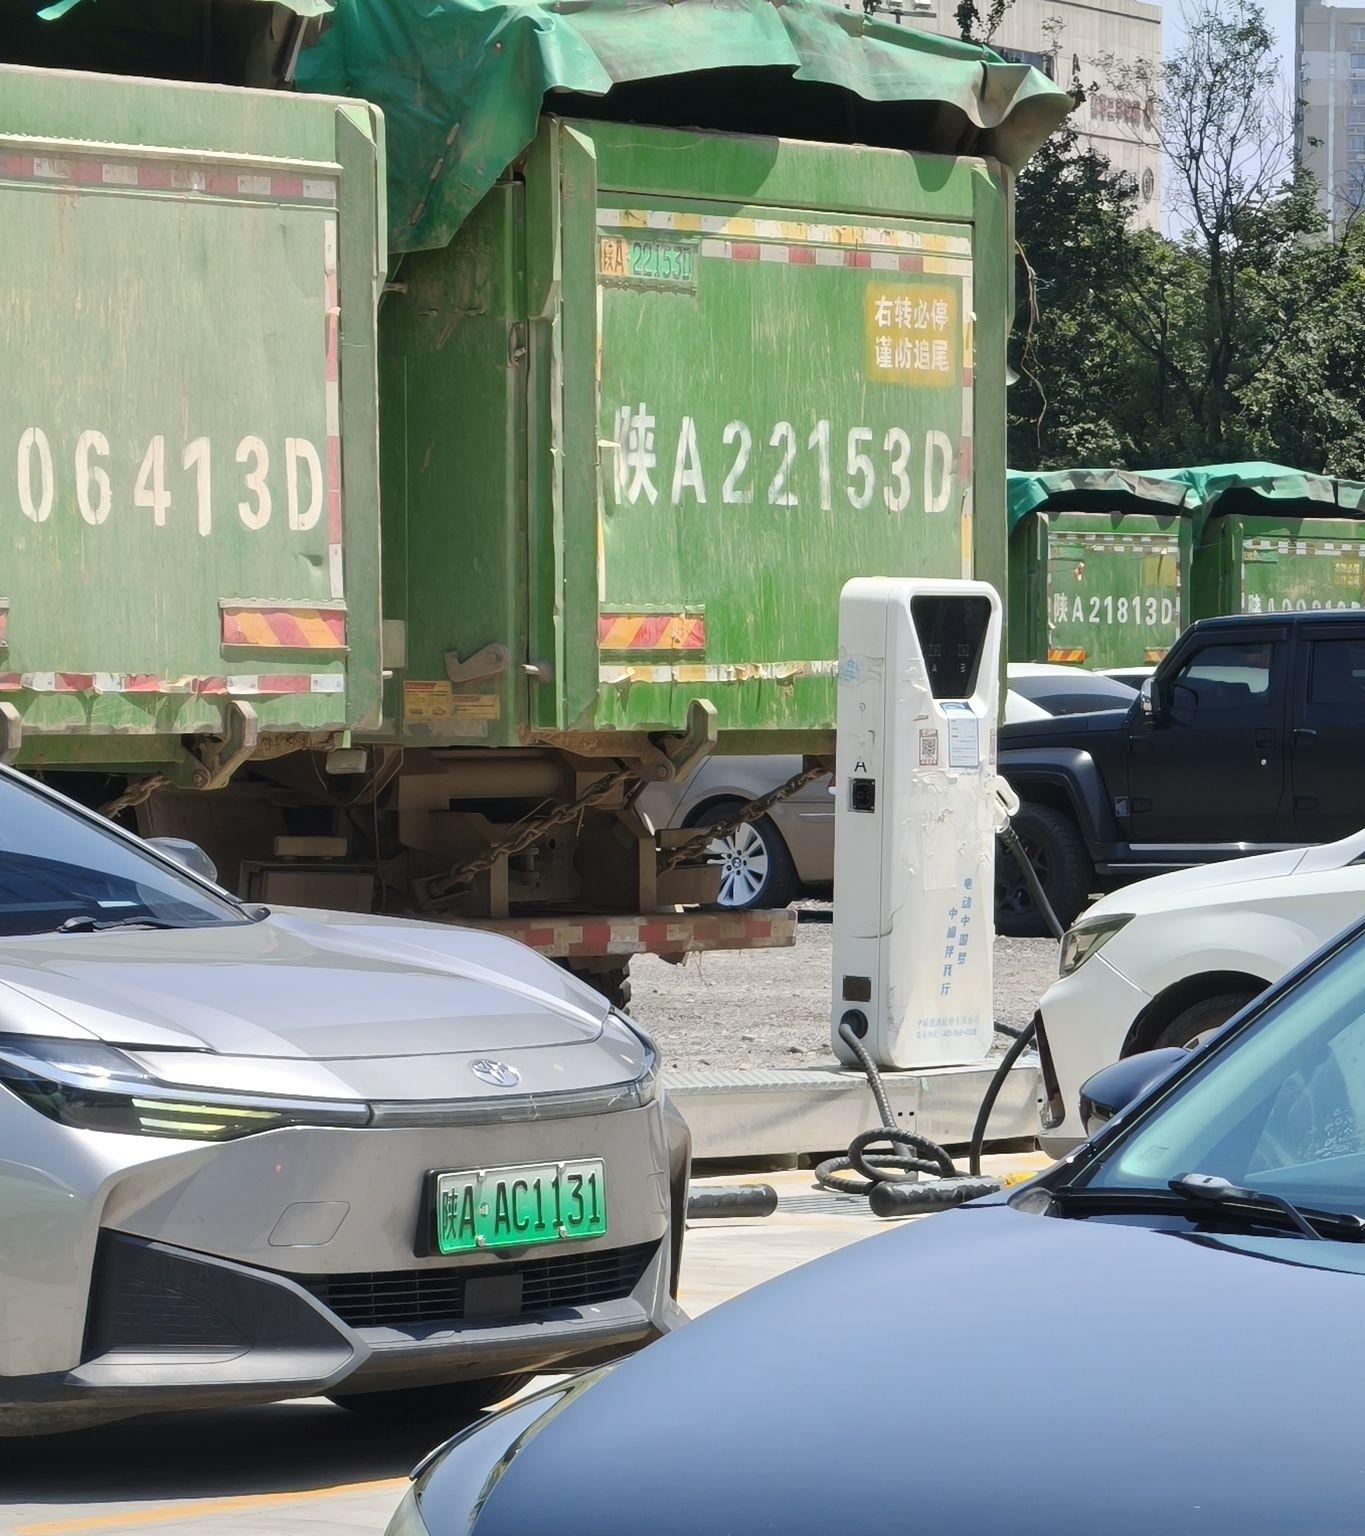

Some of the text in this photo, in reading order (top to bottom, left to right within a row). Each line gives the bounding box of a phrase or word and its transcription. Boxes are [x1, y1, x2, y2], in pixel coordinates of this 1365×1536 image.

[875, 294, 949, 332] 右转必停
[875, 335, 950, 372] 谨防追尾
[614, 402, 954, 514] 陕A22153D
[17, 426, 324, 537] 06413D
[1053, 592, 1172, 626] 陕A21813D
[854, 761, 867, 773] A
